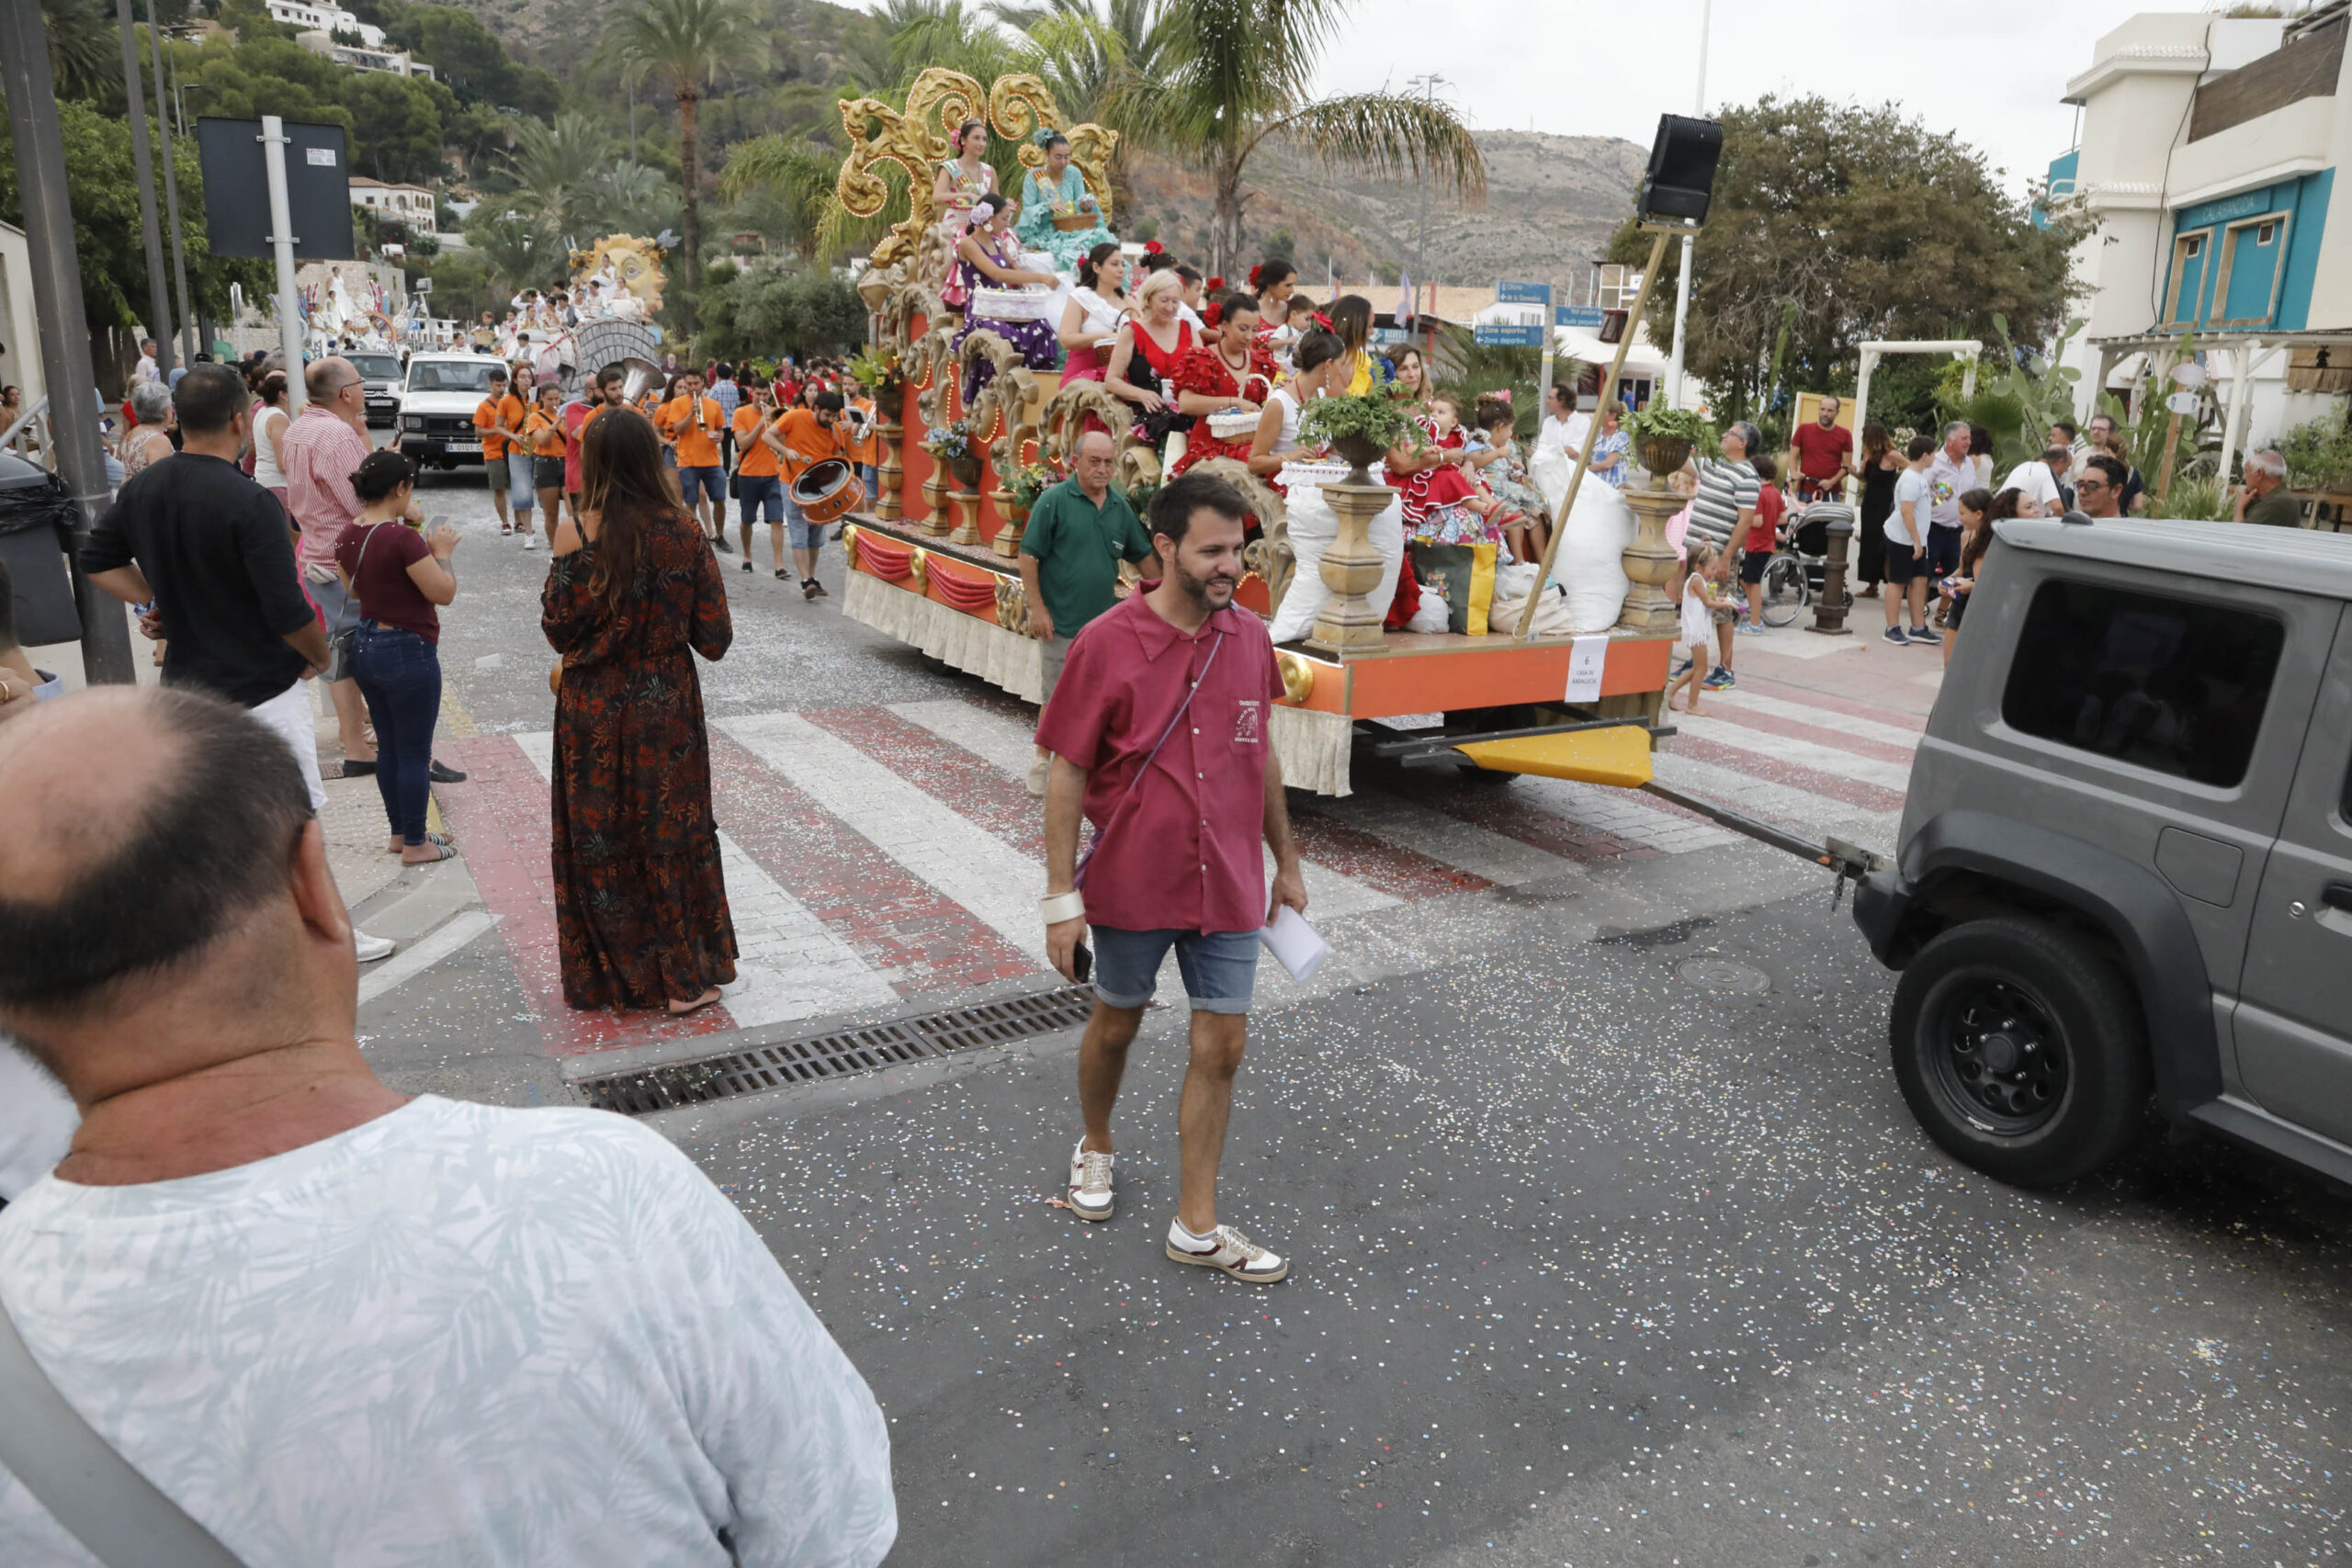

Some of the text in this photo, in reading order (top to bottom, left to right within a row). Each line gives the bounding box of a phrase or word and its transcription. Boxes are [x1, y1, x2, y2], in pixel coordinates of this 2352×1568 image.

[1500, 326, 1527, 335] esportiva
[1484, 336, 1527, 345] Zona deportiva
[1585, 656, 1590, 666] 6
